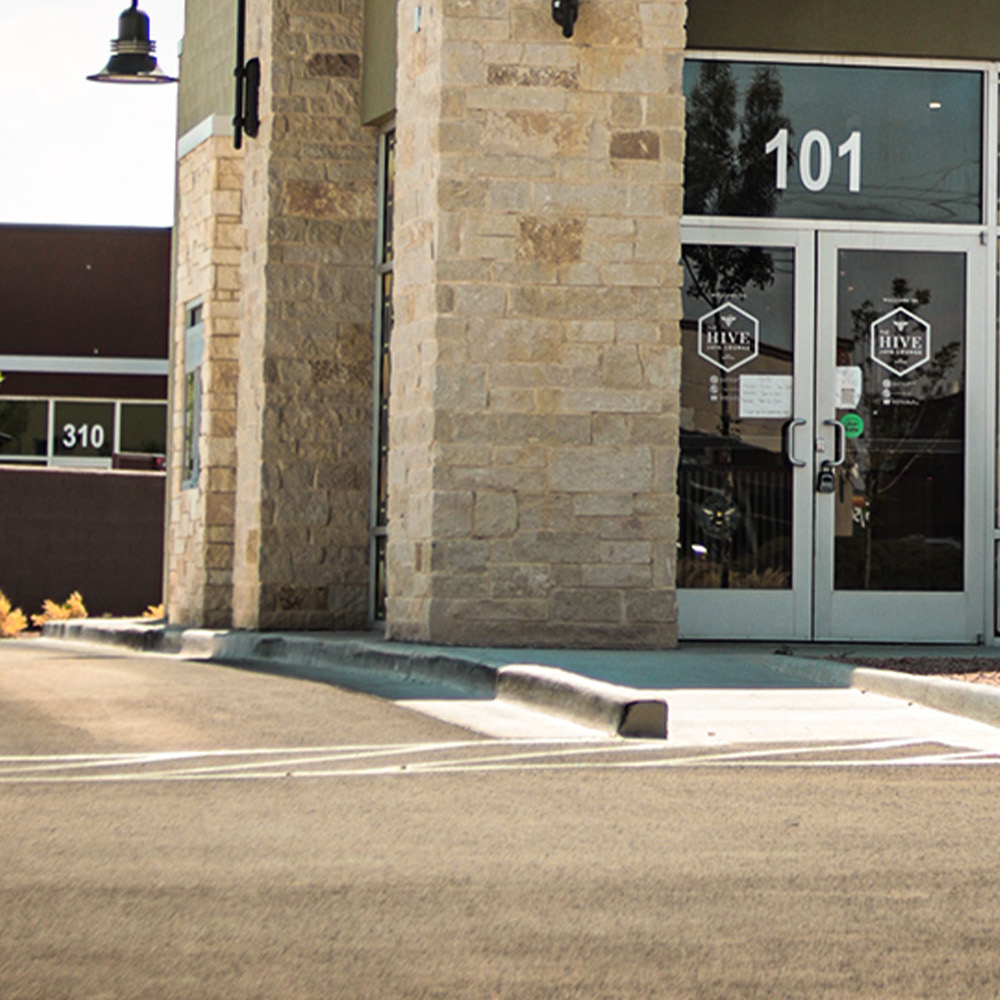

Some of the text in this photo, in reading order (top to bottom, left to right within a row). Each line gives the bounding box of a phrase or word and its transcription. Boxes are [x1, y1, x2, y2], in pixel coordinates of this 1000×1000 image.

[764, 128, 861, 192] 101
[707, 331, 751, 345] HIVE
[879, 335, 923, 349] HIVE
[62, 423, 105, 449] 310
